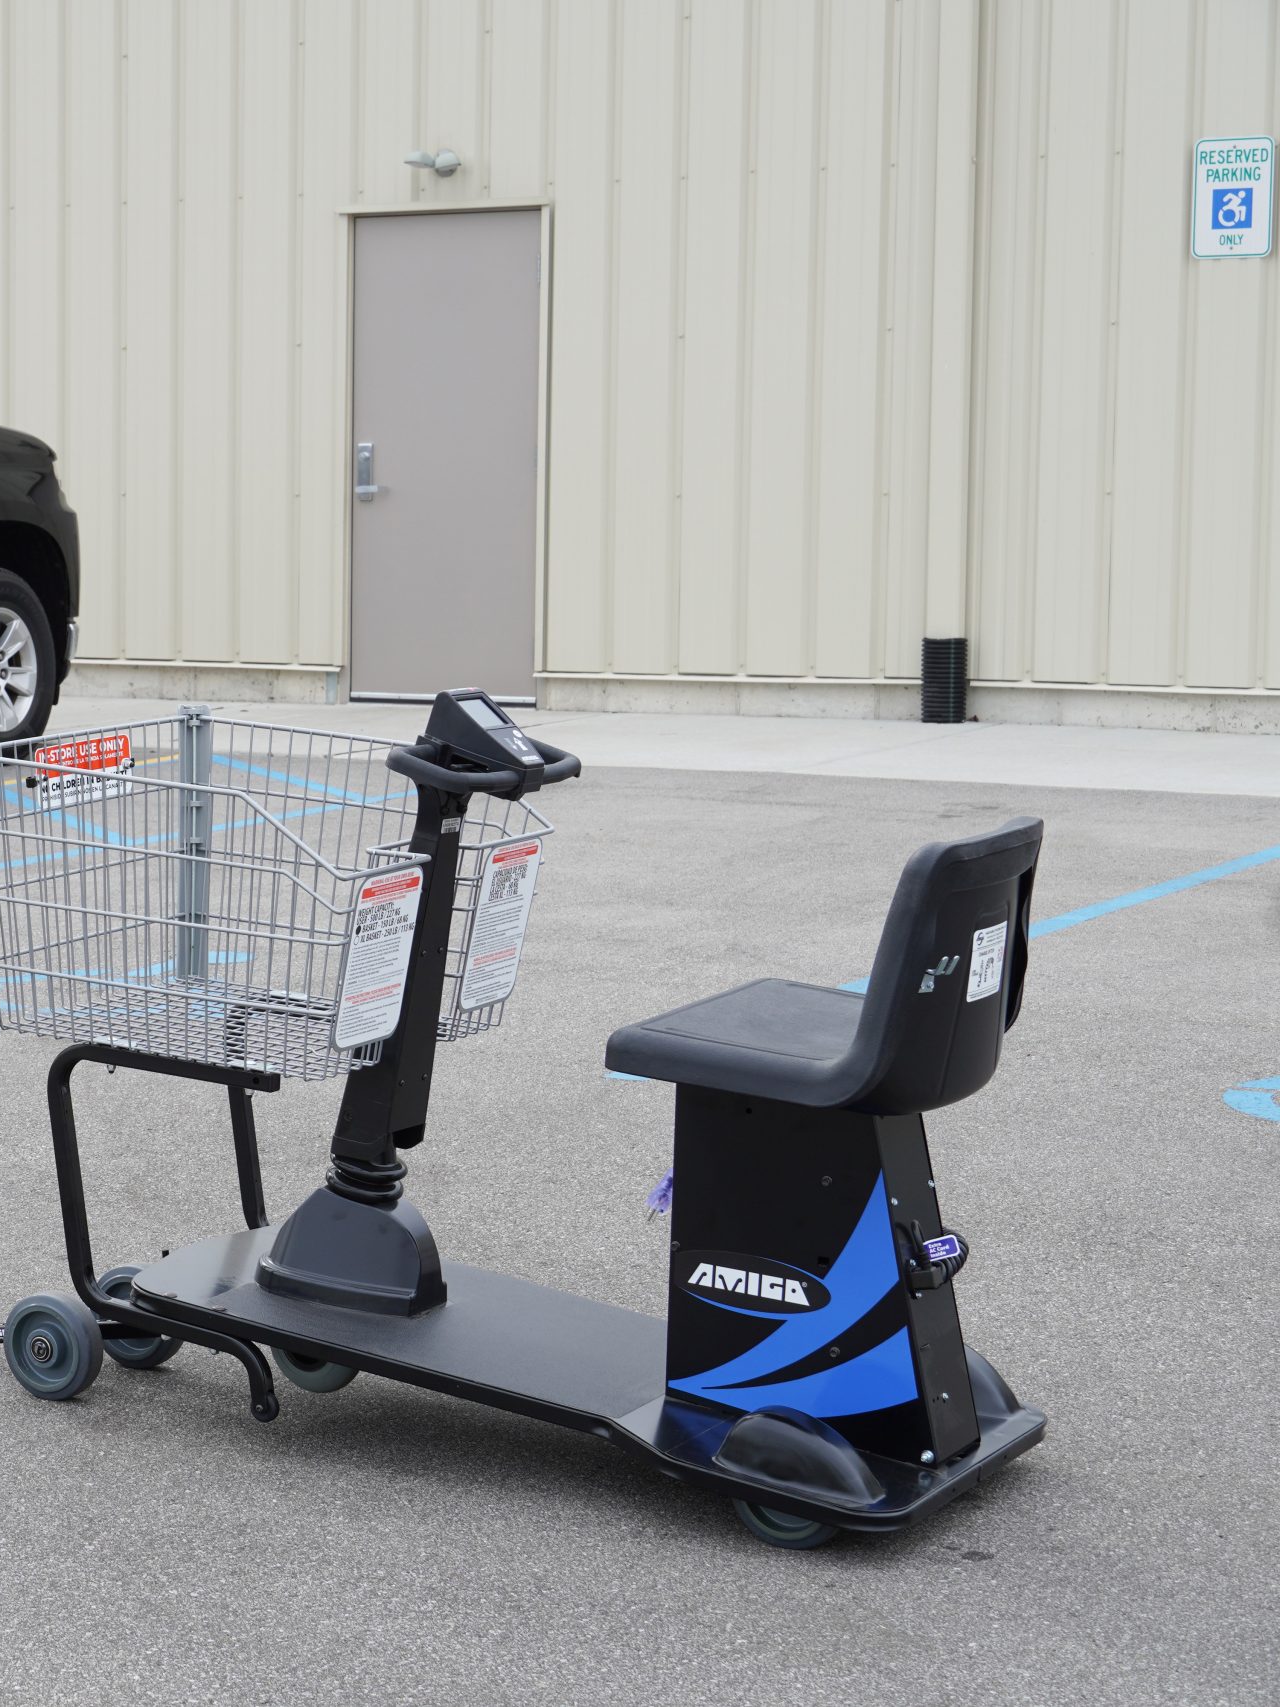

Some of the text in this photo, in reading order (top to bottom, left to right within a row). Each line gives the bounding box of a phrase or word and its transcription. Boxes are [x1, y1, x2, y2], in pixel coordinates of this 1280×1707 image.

[1199, 148, 1269, 166] RESERVED
[1206, 166, 1262, 183] PARKING
[1219, 234, 1244, 246] ONLY
[80, 743, 98, 755] USE
[937, 1244, 949, 1252] Cord
[687, 1262, 810, 1307] AMIGA
